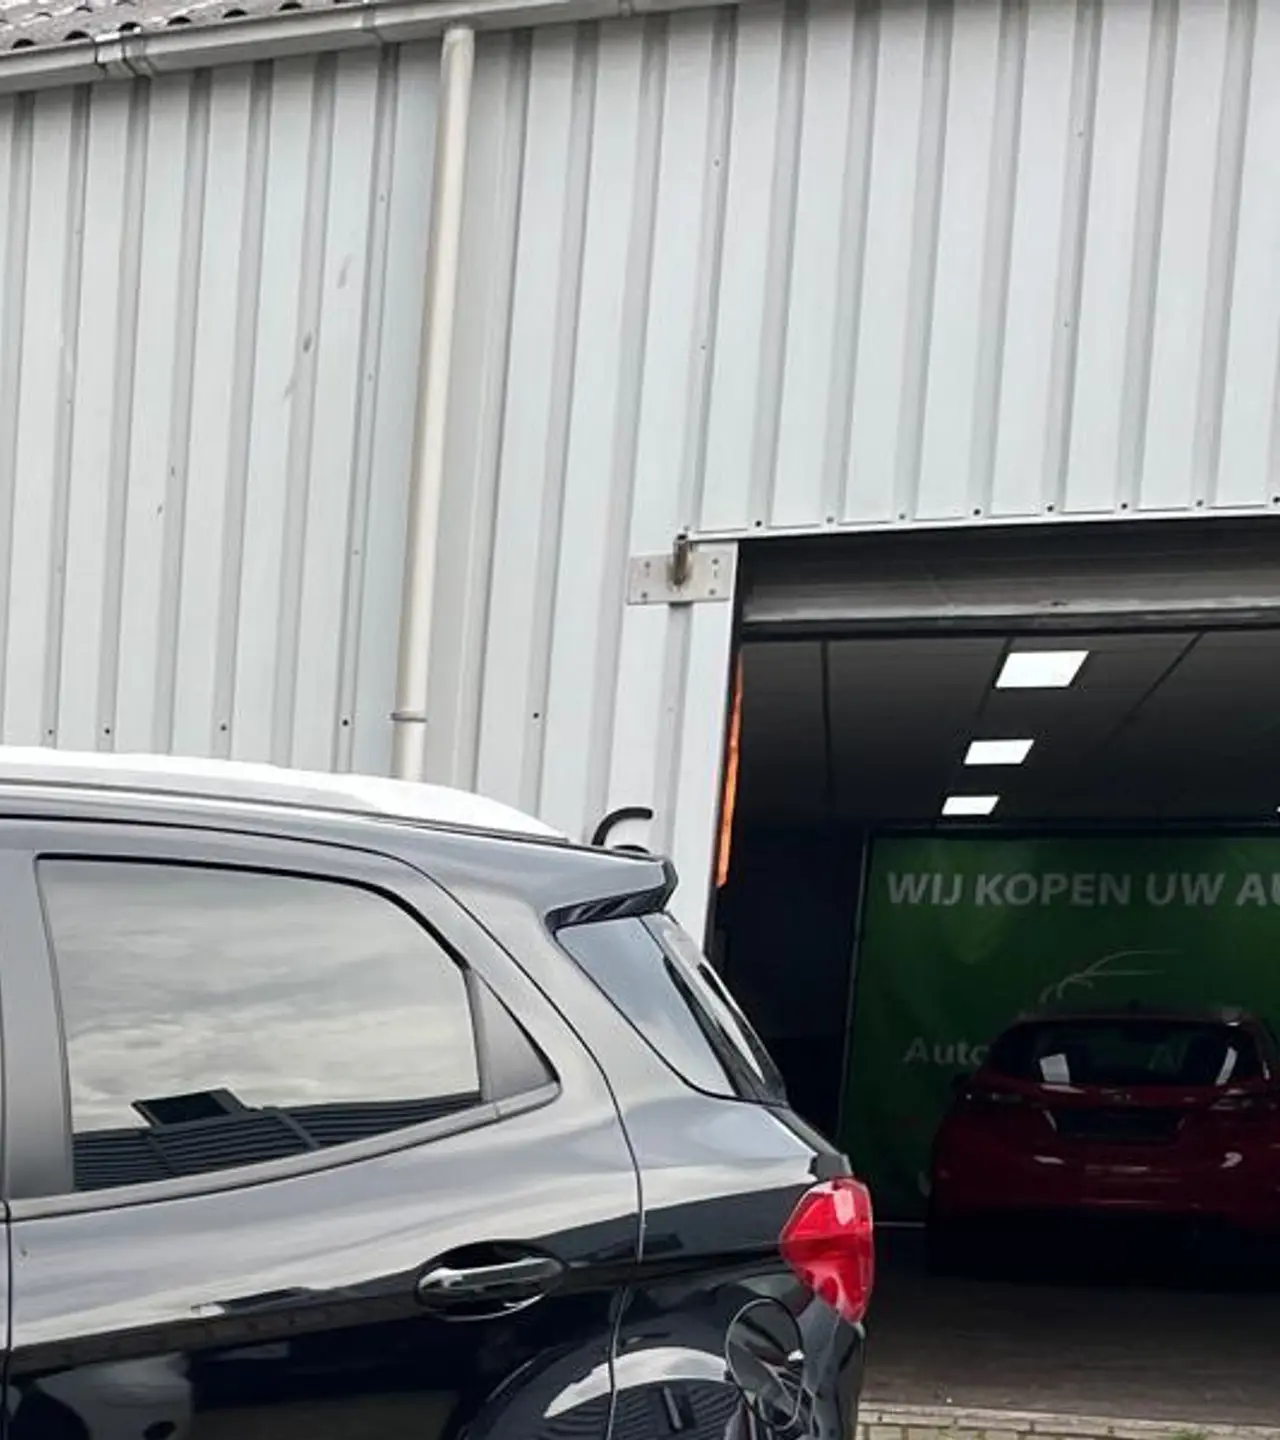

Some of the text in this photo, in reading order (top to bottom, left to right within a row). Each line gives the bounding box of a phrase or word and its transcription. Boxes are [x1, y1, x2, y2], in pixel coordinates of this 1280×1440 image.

[886, 872, 966, 907] WIJ
[975, 872, 1130, 907] KOPEN
[1145, 872, 1226, 906] UW
